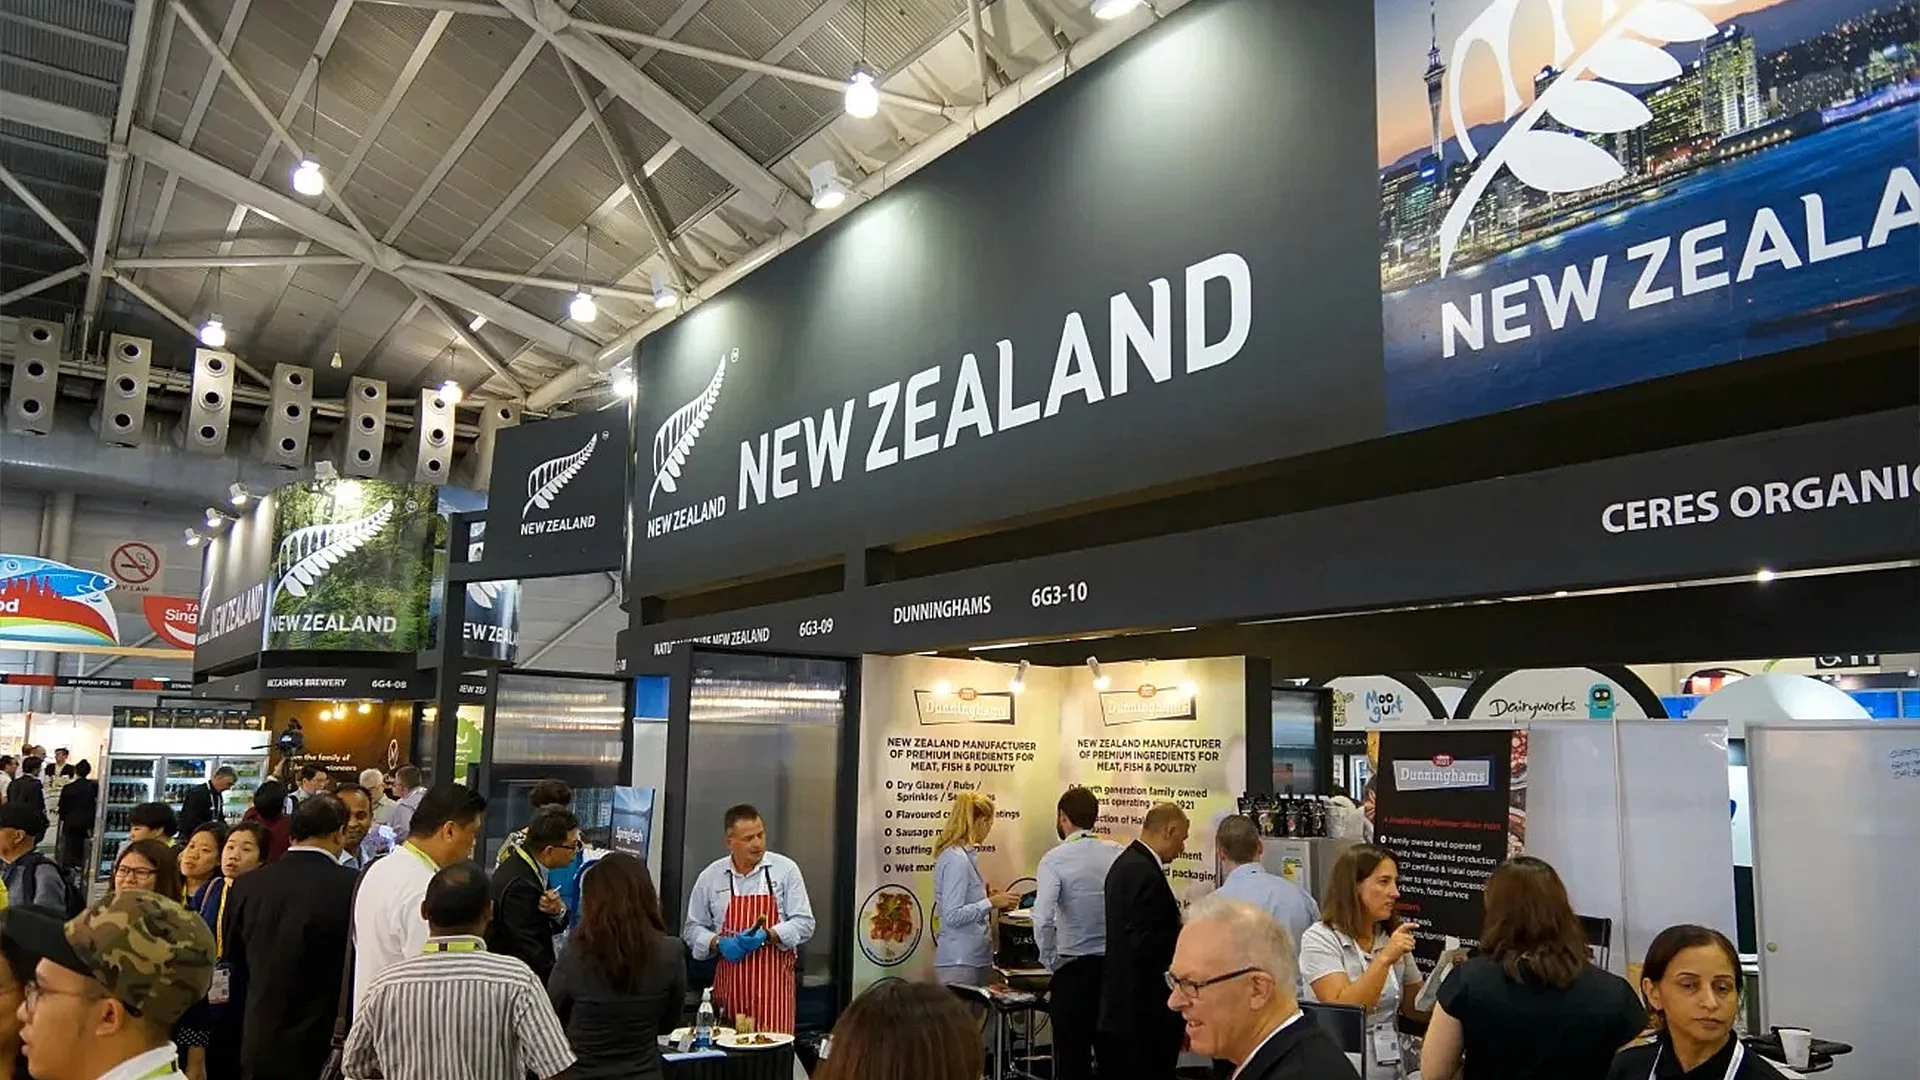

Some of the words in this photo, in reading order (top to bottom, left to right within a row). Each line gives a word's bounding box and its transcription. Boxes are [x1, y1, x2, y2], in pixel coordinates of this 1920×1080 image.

[1441, 256, 1608, 358] NEW
[1628, 166, 1920, 310] ZEALA
[738, 399, 855, 510] NEW
[865, 253, 1252, 472] ZEALAND
[1602, 491, 1720, 533] CERES
[1730, 464, 1920, 518] ORGANI
[648, 513, 673, 538] NEW
[673, 496, 726, 531] ZEALAND
[520, 522, 546, 535] NEW
[547, 514, 596, 532] ZEALAND
[226, 583, 264, 633] ZEALAND
[893, 595, 992, 624] DUNNINGHAMS
[1031, 581, 1088, 607] 6G3-10
[165, 608, 197, 624] Sing
[270, 615, 300, 632] NEW
[303, 614, 397, 633] ZEALAND
[799, 618, 834, 637] 6G3-09
[731, 627, 770, 646] ZEALAND
[304, 678, 347, 687] BREWERY
[371, 679, 407, 689] 6G4-08
[1365, 690, 1394, 709] Moo
[925, 701, 1010, 719] Dunninghams
[1488, 695, 1577, 720] Dairyworks
[887, 737, 912, 747] NEW
[914, 738, 960, 749] ZEALAND
[962, 740, 1037, 751] MANUFACTURER
[1077, 739, 1097, 748] NEW
[1099, 739, 1141, 748] ZEALAND
[1143, 739, 1221, 749] MANUFACTURER
[318, 753, 342, 763] family
[342, 753, 351, 761] of
[890, 750, 903, 759] OF
[906, 750, 951, 760] PREMIUM
[953, 751, 1014, 761] INGREDIENTS
[1016, 752, 1035, 762] FOR
[1079, 751, 1090, 760] OF
[1093, 751, 1132, 760] PREMIUM
[1134, 751, 1196, 761] INGREDIENTS
[1198, 751, 1219, 762] FOR
[910, 761, 940, 773] MEAT,
[942, 762, 963, 772] FISH
[965, 763, 972, 772] &
[974, 763, 1016, 773] POULTRY
[1097, 762, 1122, 773] MEAT,
[1123, 762, 1144, 772] FISH
[1145, 763, 1151, 772] &
[1154, 762, 1197, 774] POULTRY
[1400, 767, 1486, 785] Dunninghams
[897, 781, 913, 791] Dry
[915, 780, 944, 790] Glazes
[953, 781, 975, 790] Rubs
[1104, 786, 1147, 797] generation
[1149, 786, 1175, 798] family
[1177, 788, 1208, 798] owned
[896, 792, 938, 802] Sprinkles
[1111, 799, 1150, 810] operating
[896, 810, 941, 819] Flavoured
[1121, 816, 1130, 824] of
[896, 828, 934, 838] Sausage
[1388, 836, 1409, 847] Family
[1411, 839, 1434, 847] owned
[1435, 841, 1448, 849] and
[1449, 842, 1481, 851] operated
[895, 846, 932, 856] Stuffing
[1411, 851, 1427, 859] New
[1428, 852, 1455, 862] Zealand
[1457, 854, 1497, 866] production
[895, 864, 914, 873] Wet
[1411, 863, 1440, 873] certified
[1440, 865, 1445, 873] &
[1447, 866, 1466, 875] Halal
[1414, 876, 1422, 884] to
[1422, 878, 1452, 888] retailers,
[1426, 886, 1443, 896] food
[1444, 889, 1469, 900] service
